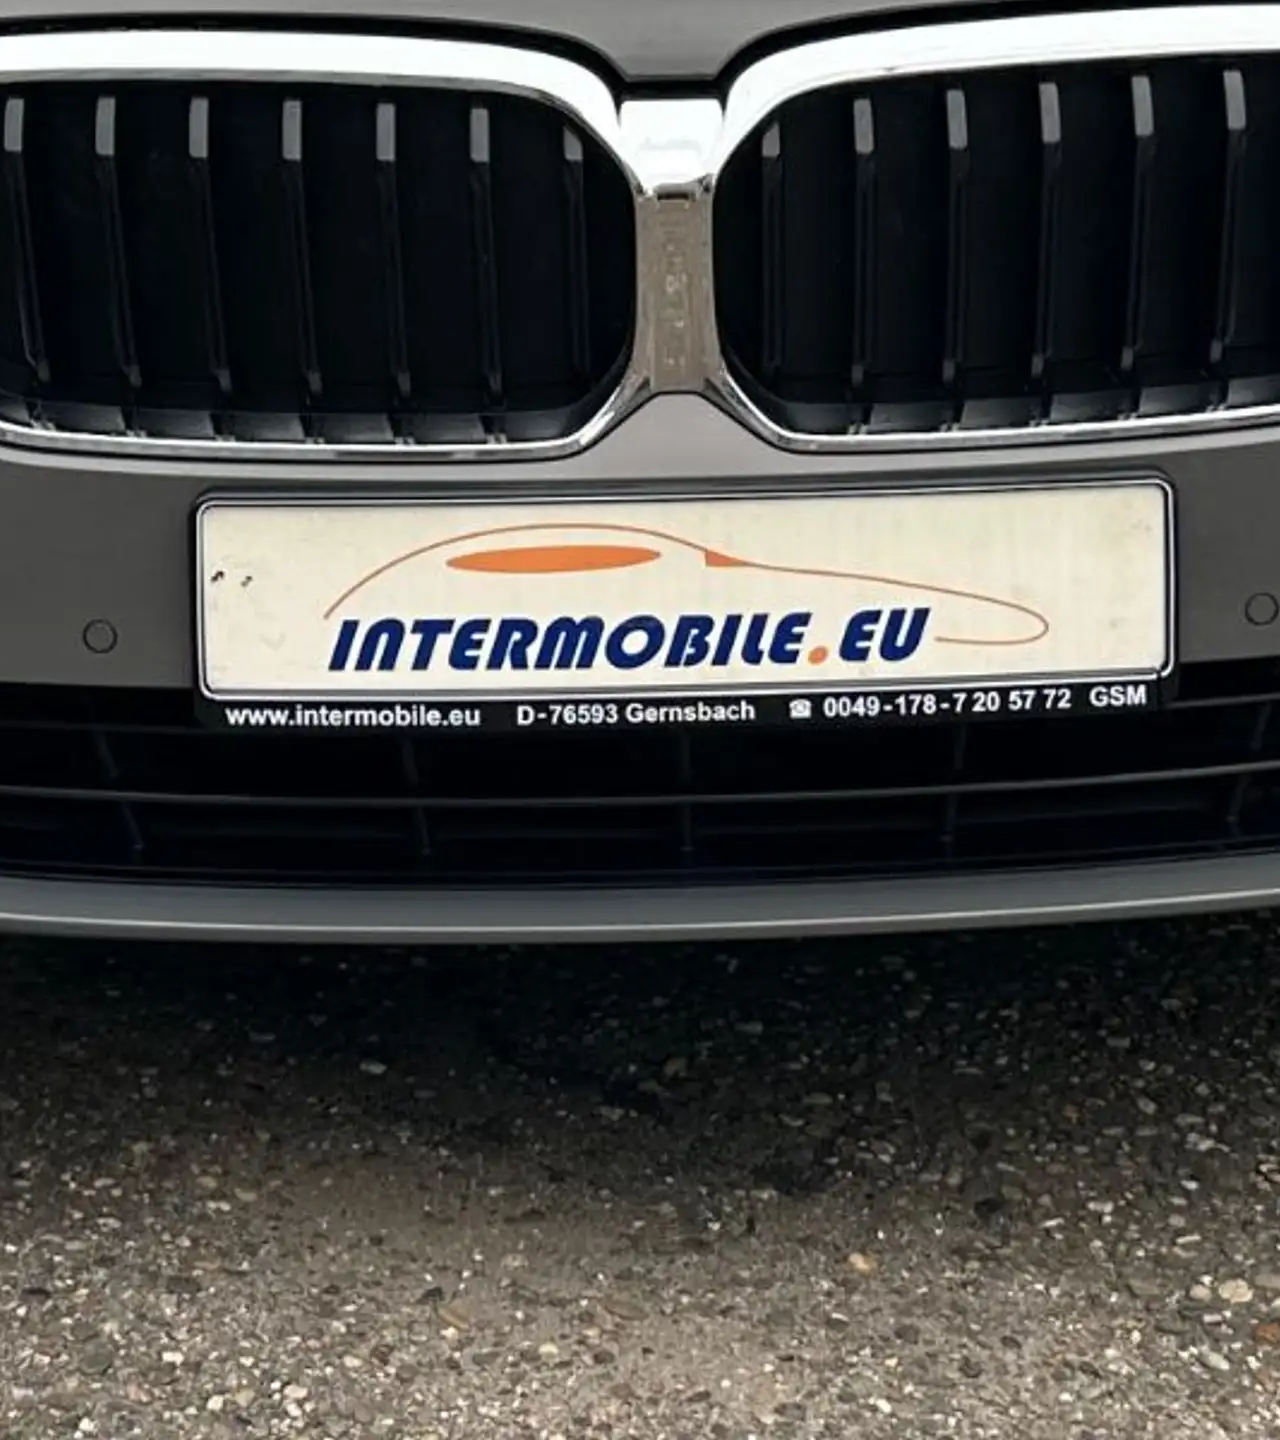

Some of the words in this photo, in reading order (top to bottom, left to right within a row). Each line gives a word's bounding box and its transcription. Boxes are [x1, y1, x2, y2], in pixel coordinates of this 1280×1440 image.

[328, 608, 930, 671] INTERMOBILE.EU
[225, 704, 481, 727] www.intermobile.eu
[517, 704, 618, 726] D-76593
[625, 699, 756, 723] Gernsbach
[1008, 690, 1037, 711] 57
[1044, 688, 1072, 709] 72
[1089, 684, 1147, 707] GSM
